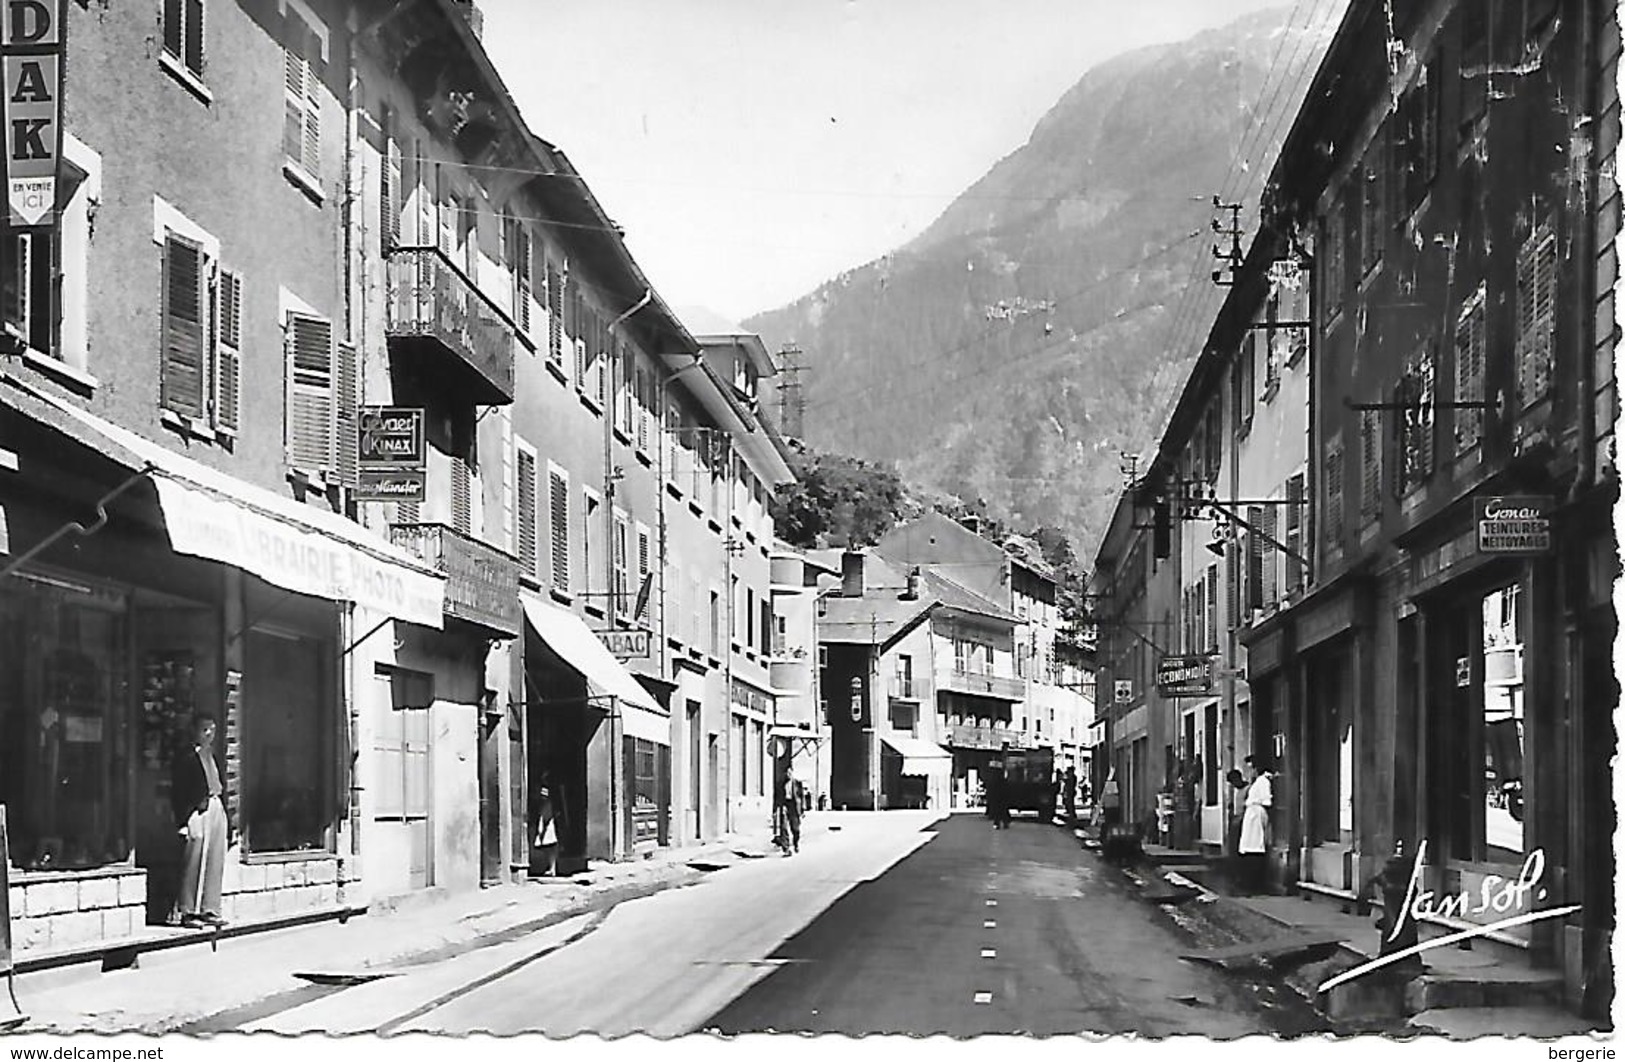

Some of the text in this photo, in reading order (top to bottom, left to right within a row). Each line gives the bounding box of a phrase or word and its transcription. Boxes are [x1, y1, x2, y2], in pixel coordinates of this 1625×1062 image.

[22, 195, 43, 208] ICI
[371, 437, 411, 455] KINAX
[237, 514, 344, 582] LIBRAIRIE
[348, 552, 405, 606] PHOTO
[1158, 664, 1210, 685] ECONOMIQUE
